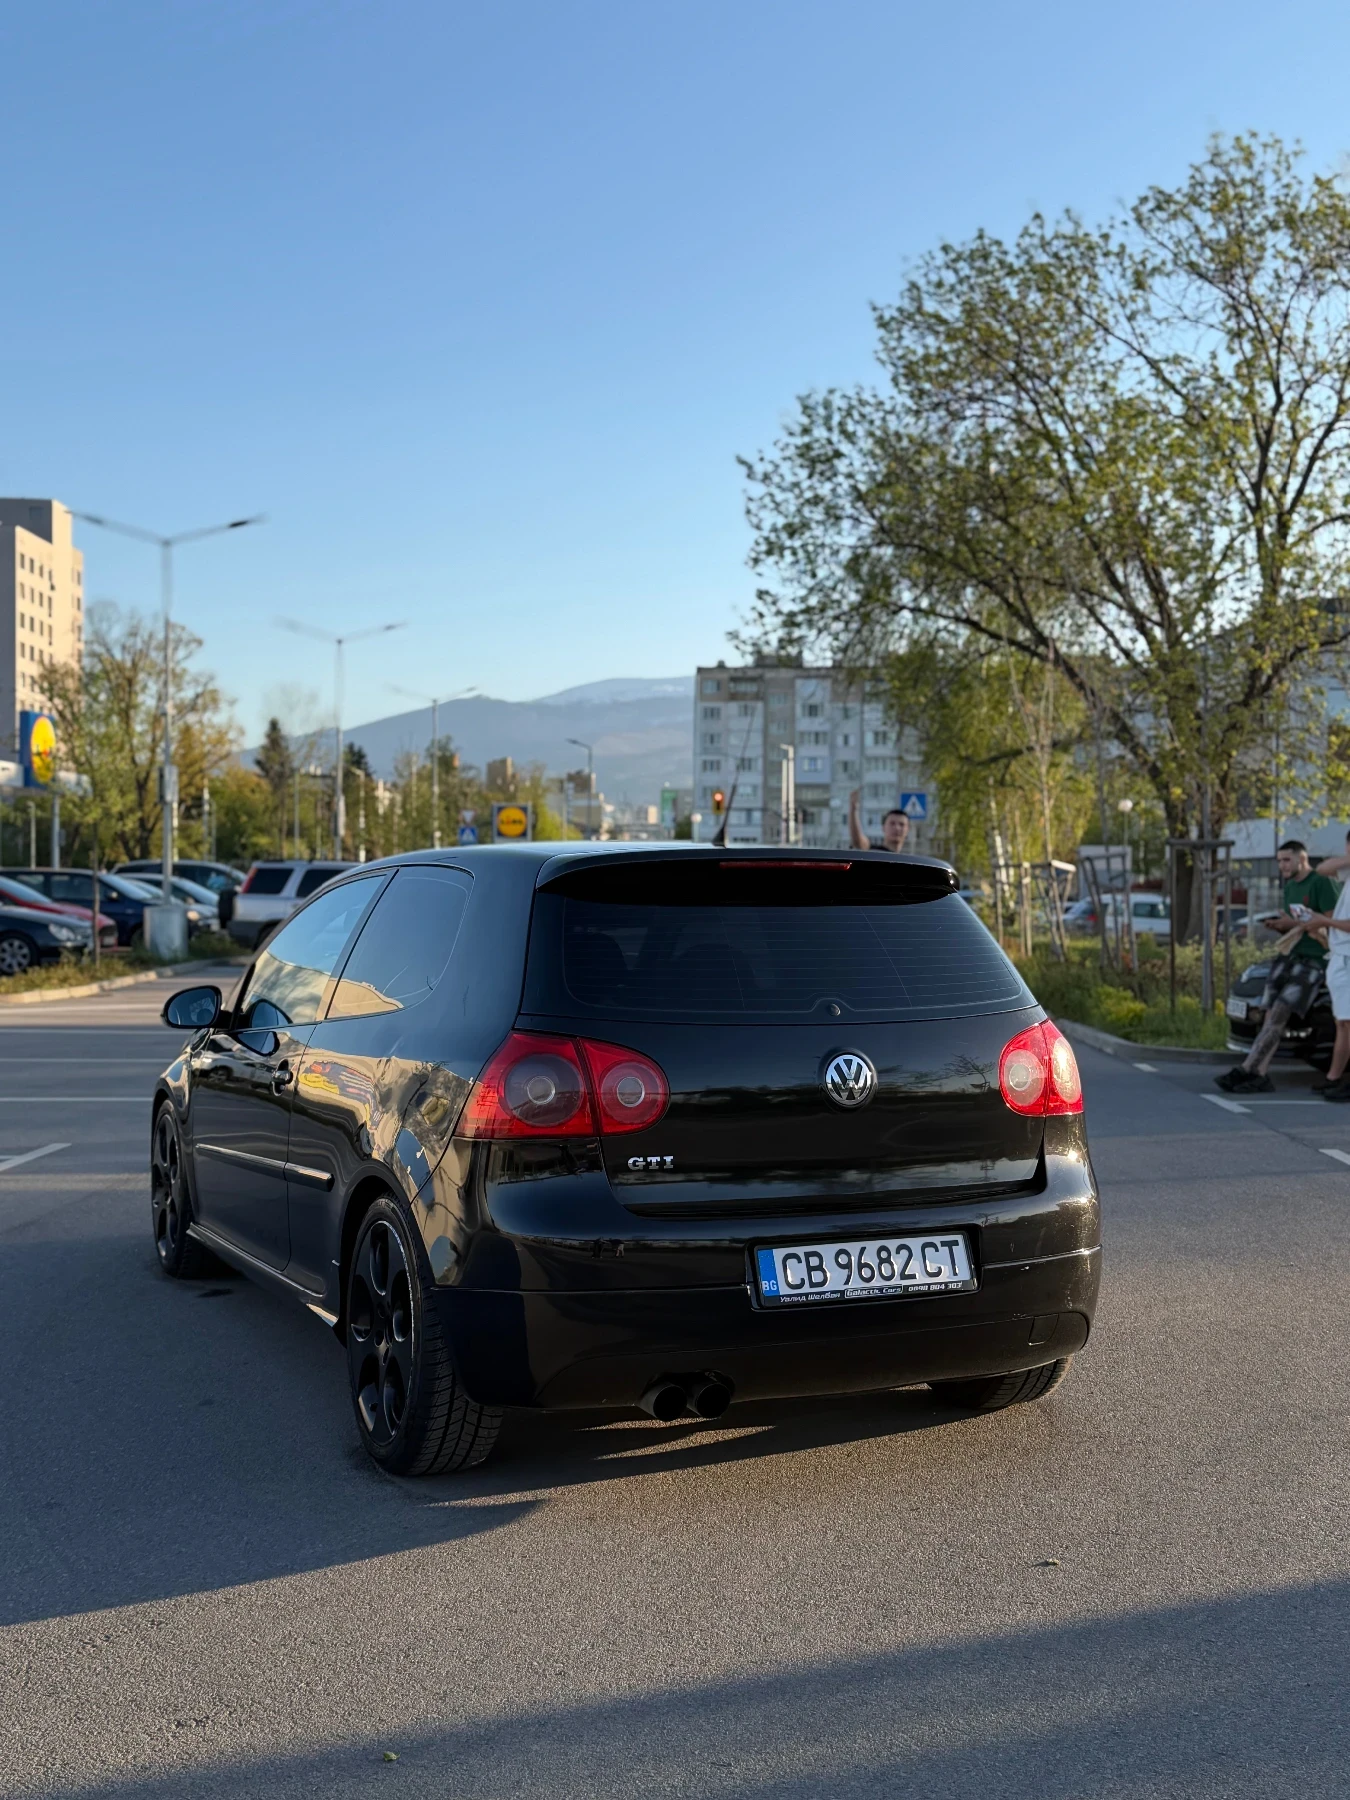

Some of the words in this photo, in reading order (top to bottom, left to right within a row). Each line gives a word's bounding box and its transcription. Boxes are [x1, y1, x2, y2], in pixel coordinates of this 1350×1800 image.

[628, 1155, 674, 1170] GTI
[781, 1250, 830, 1290] CB
[834, 1243, 919, 1286] 9682
[761, 1280, 778, 1291] BG
